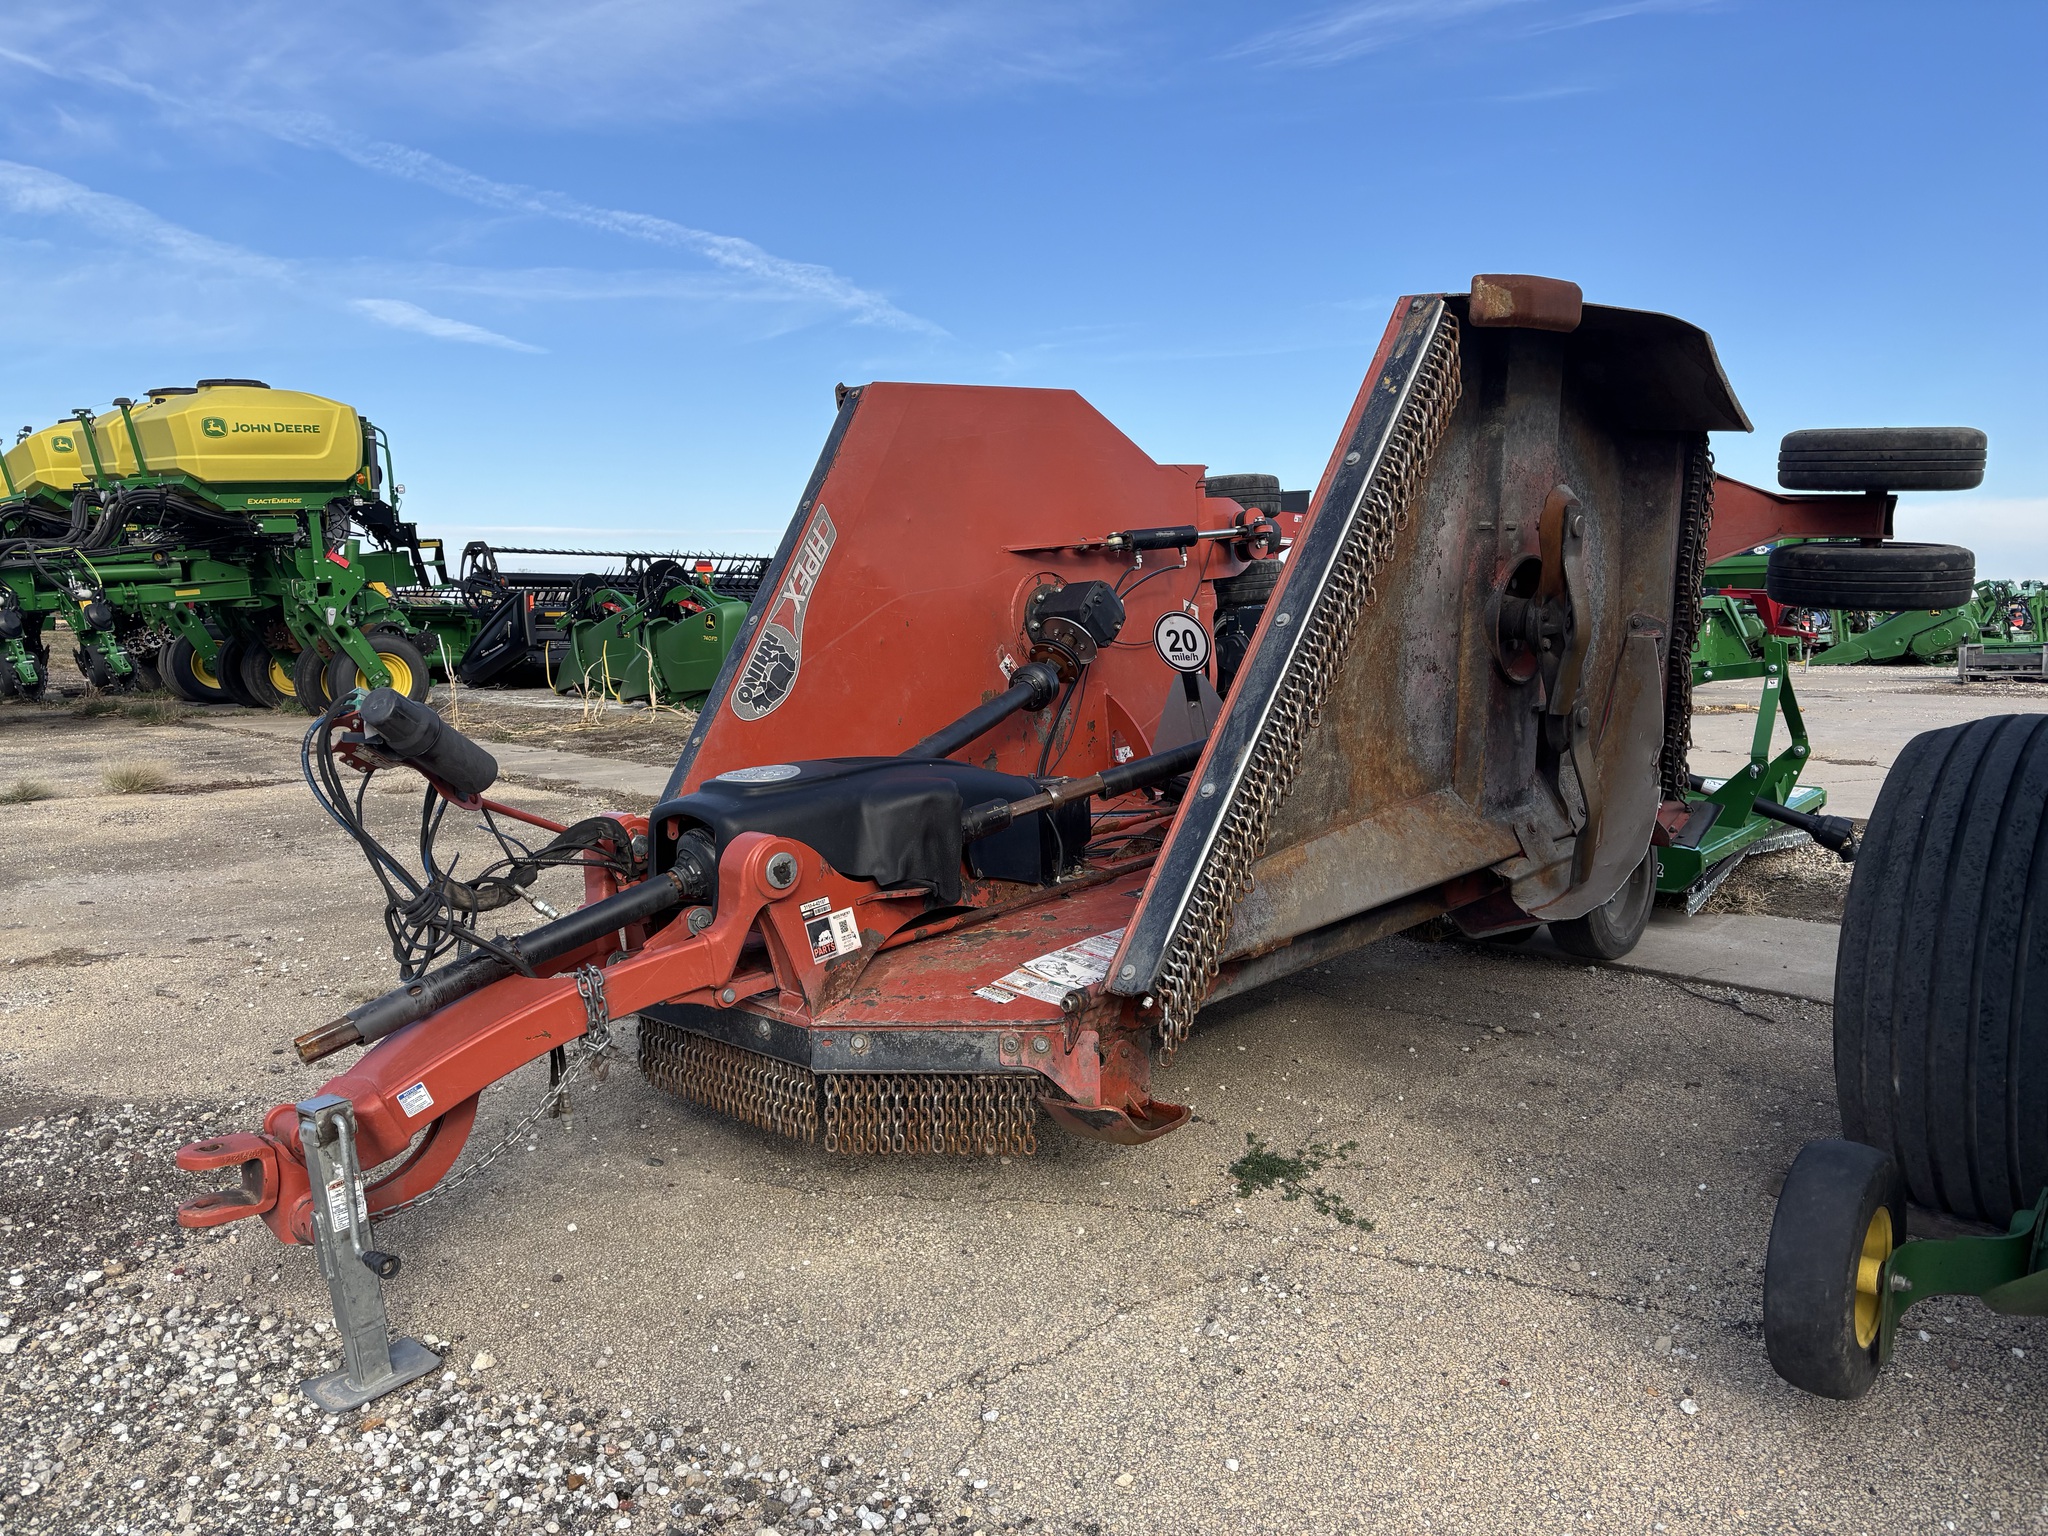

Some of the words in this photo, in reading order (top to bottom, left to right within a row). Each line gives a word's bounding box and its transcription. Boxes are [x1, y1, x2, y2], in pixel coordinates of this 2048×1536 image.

[231, 422, 271, 433] JOHN
[274, 422, 321, 434] DEERE
[782, 526, 829, 613] APEX
[1166, 629, 1198, 653] 20
[1171, 652, 1199, 662] mile/h
[738, 630, 781, 705] RHINO
[813, 942, 836, 957] PARTS
